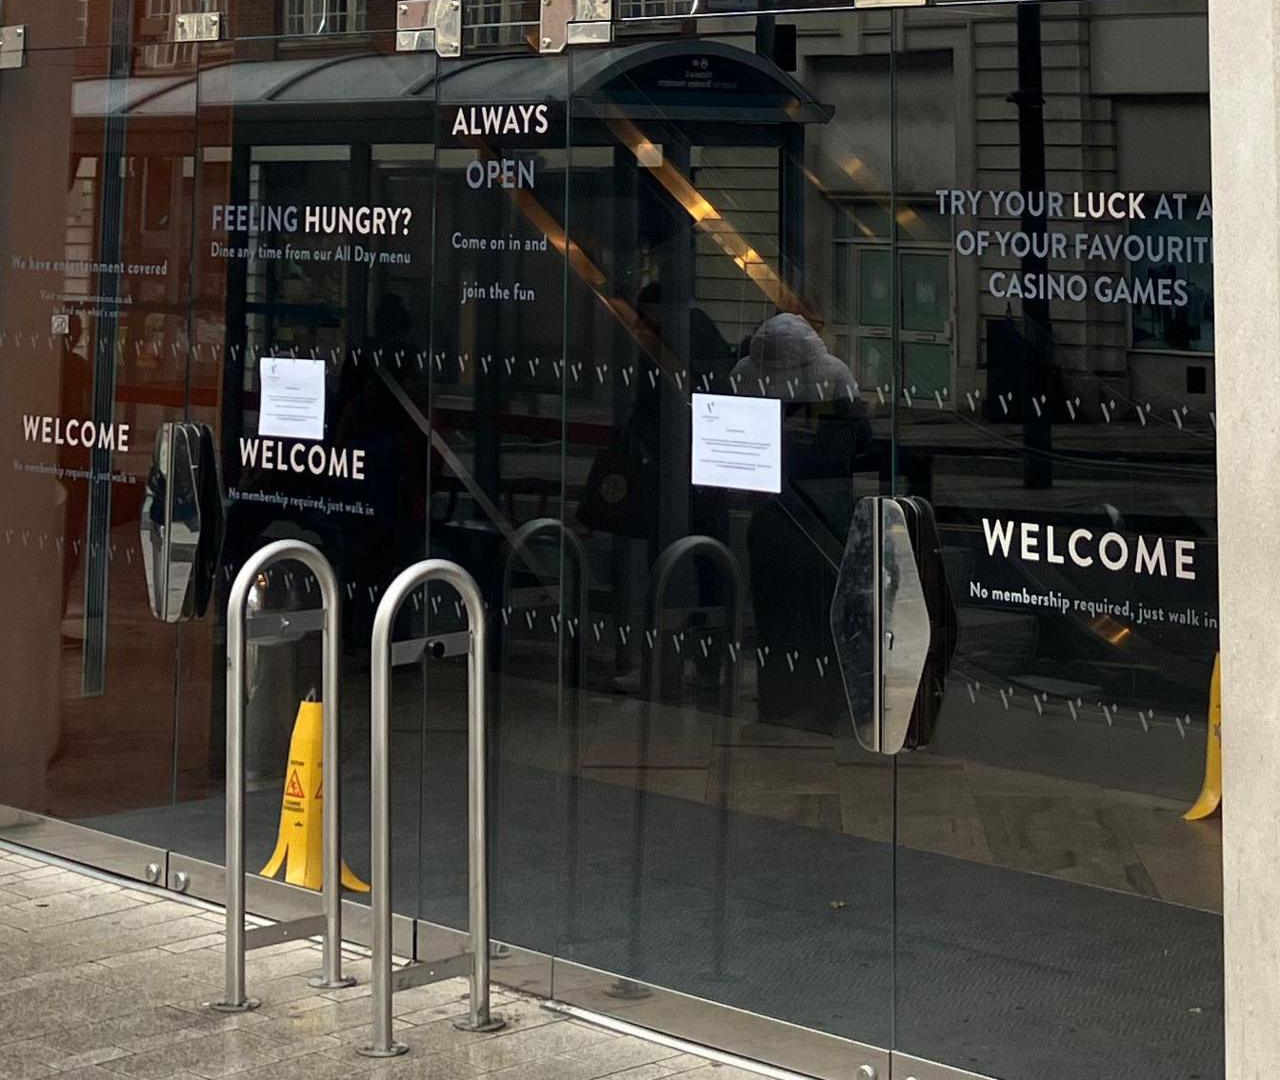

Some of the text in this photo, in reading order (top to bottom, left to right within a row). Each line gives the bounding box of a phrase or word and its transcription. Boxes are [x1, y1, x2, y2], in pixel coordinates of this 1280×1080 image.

[452, 105, 548, 135] ALWAYS
[466, 159, 535, 189] OPEN
[212, 205, 412, 235] FEELING HUNGRY?
[935, 190, 982, 216] TRY
[989, 191, 1063, 217] YOUR
[1073, 192, 1146, 219] LUCK
[1154, 193, 1187, 220] AT
[211, 242, 411, 268] Dine any time from our All Day menu
[452, 232, 547, 251] Come on in and
[956, 230, 1213, 263] OF YOUR FAVOURIT
[128, 260, 168, 275] covered
[461, 281, 535, 304] join the fun
[989, 272, 1188, 307] CASINO GAMES
[23, 415, 130, 452] WELCOME
[240, 437, 365, 480] WELCOME
[228, 487, 374, 516] No membership required, just walk in
[982, 517, 1196, 580] WELCOME
[970, 581, 1217, 629] No membership required, just walk in
